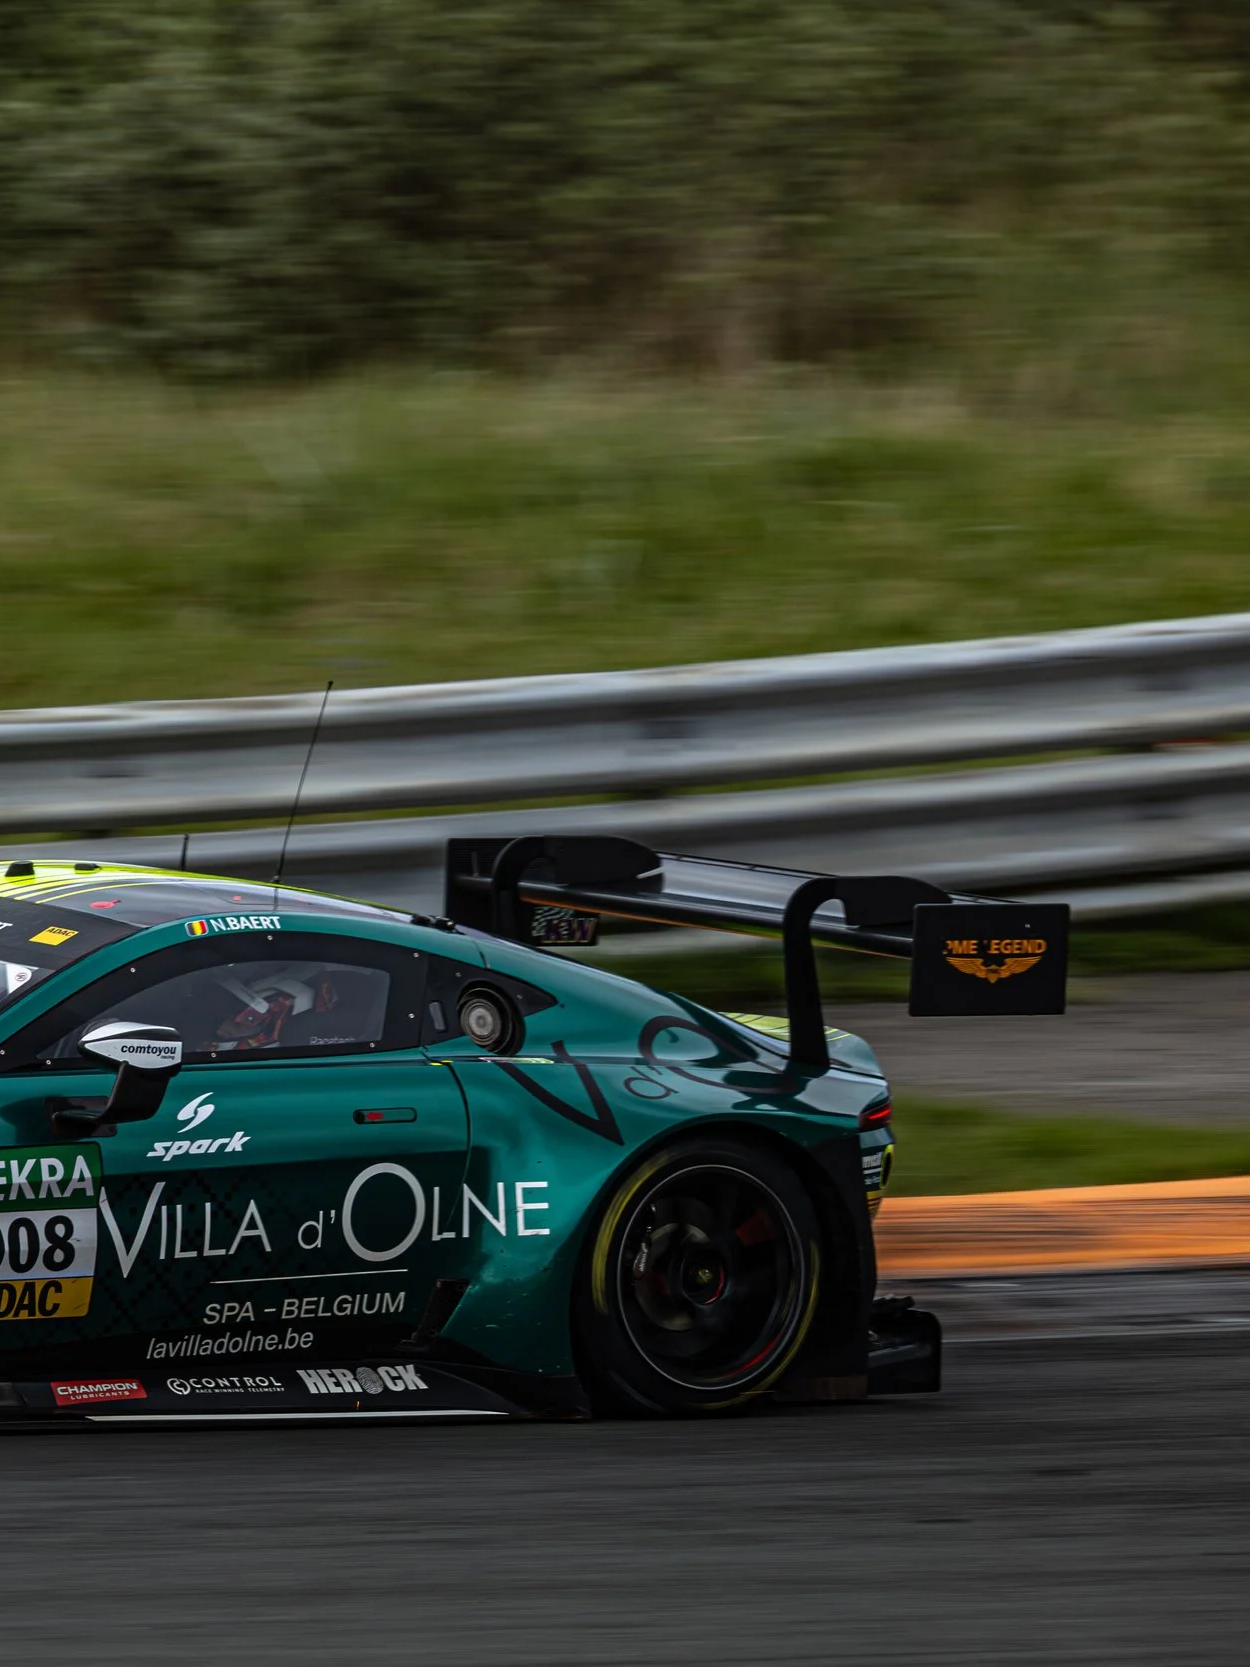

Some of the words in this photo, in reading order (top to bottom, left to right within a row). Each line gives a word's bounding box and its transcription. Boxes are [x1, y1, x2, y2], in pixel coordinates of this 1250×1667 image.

[45, 926, 76, 937] ADAC
[209, 916, 282, 932] N.BAERT
[120, 1044, 177, 1057] comtoyou
[146, 1131, 252, 1162] spark
[99, 1181, 273, 1279] VILLA
[202, 1301, 255, 1325] SPA
[281, 1291, 406, 1320] BELGIUM
[146, 1327, 314, 1360] lavilladolne.be
[56, 1382, 139, 1396] CHAMPION
[188, 1376, 282, 1389] CONTROL
[69, 1390, 130, 1400] LUBRICANTS
